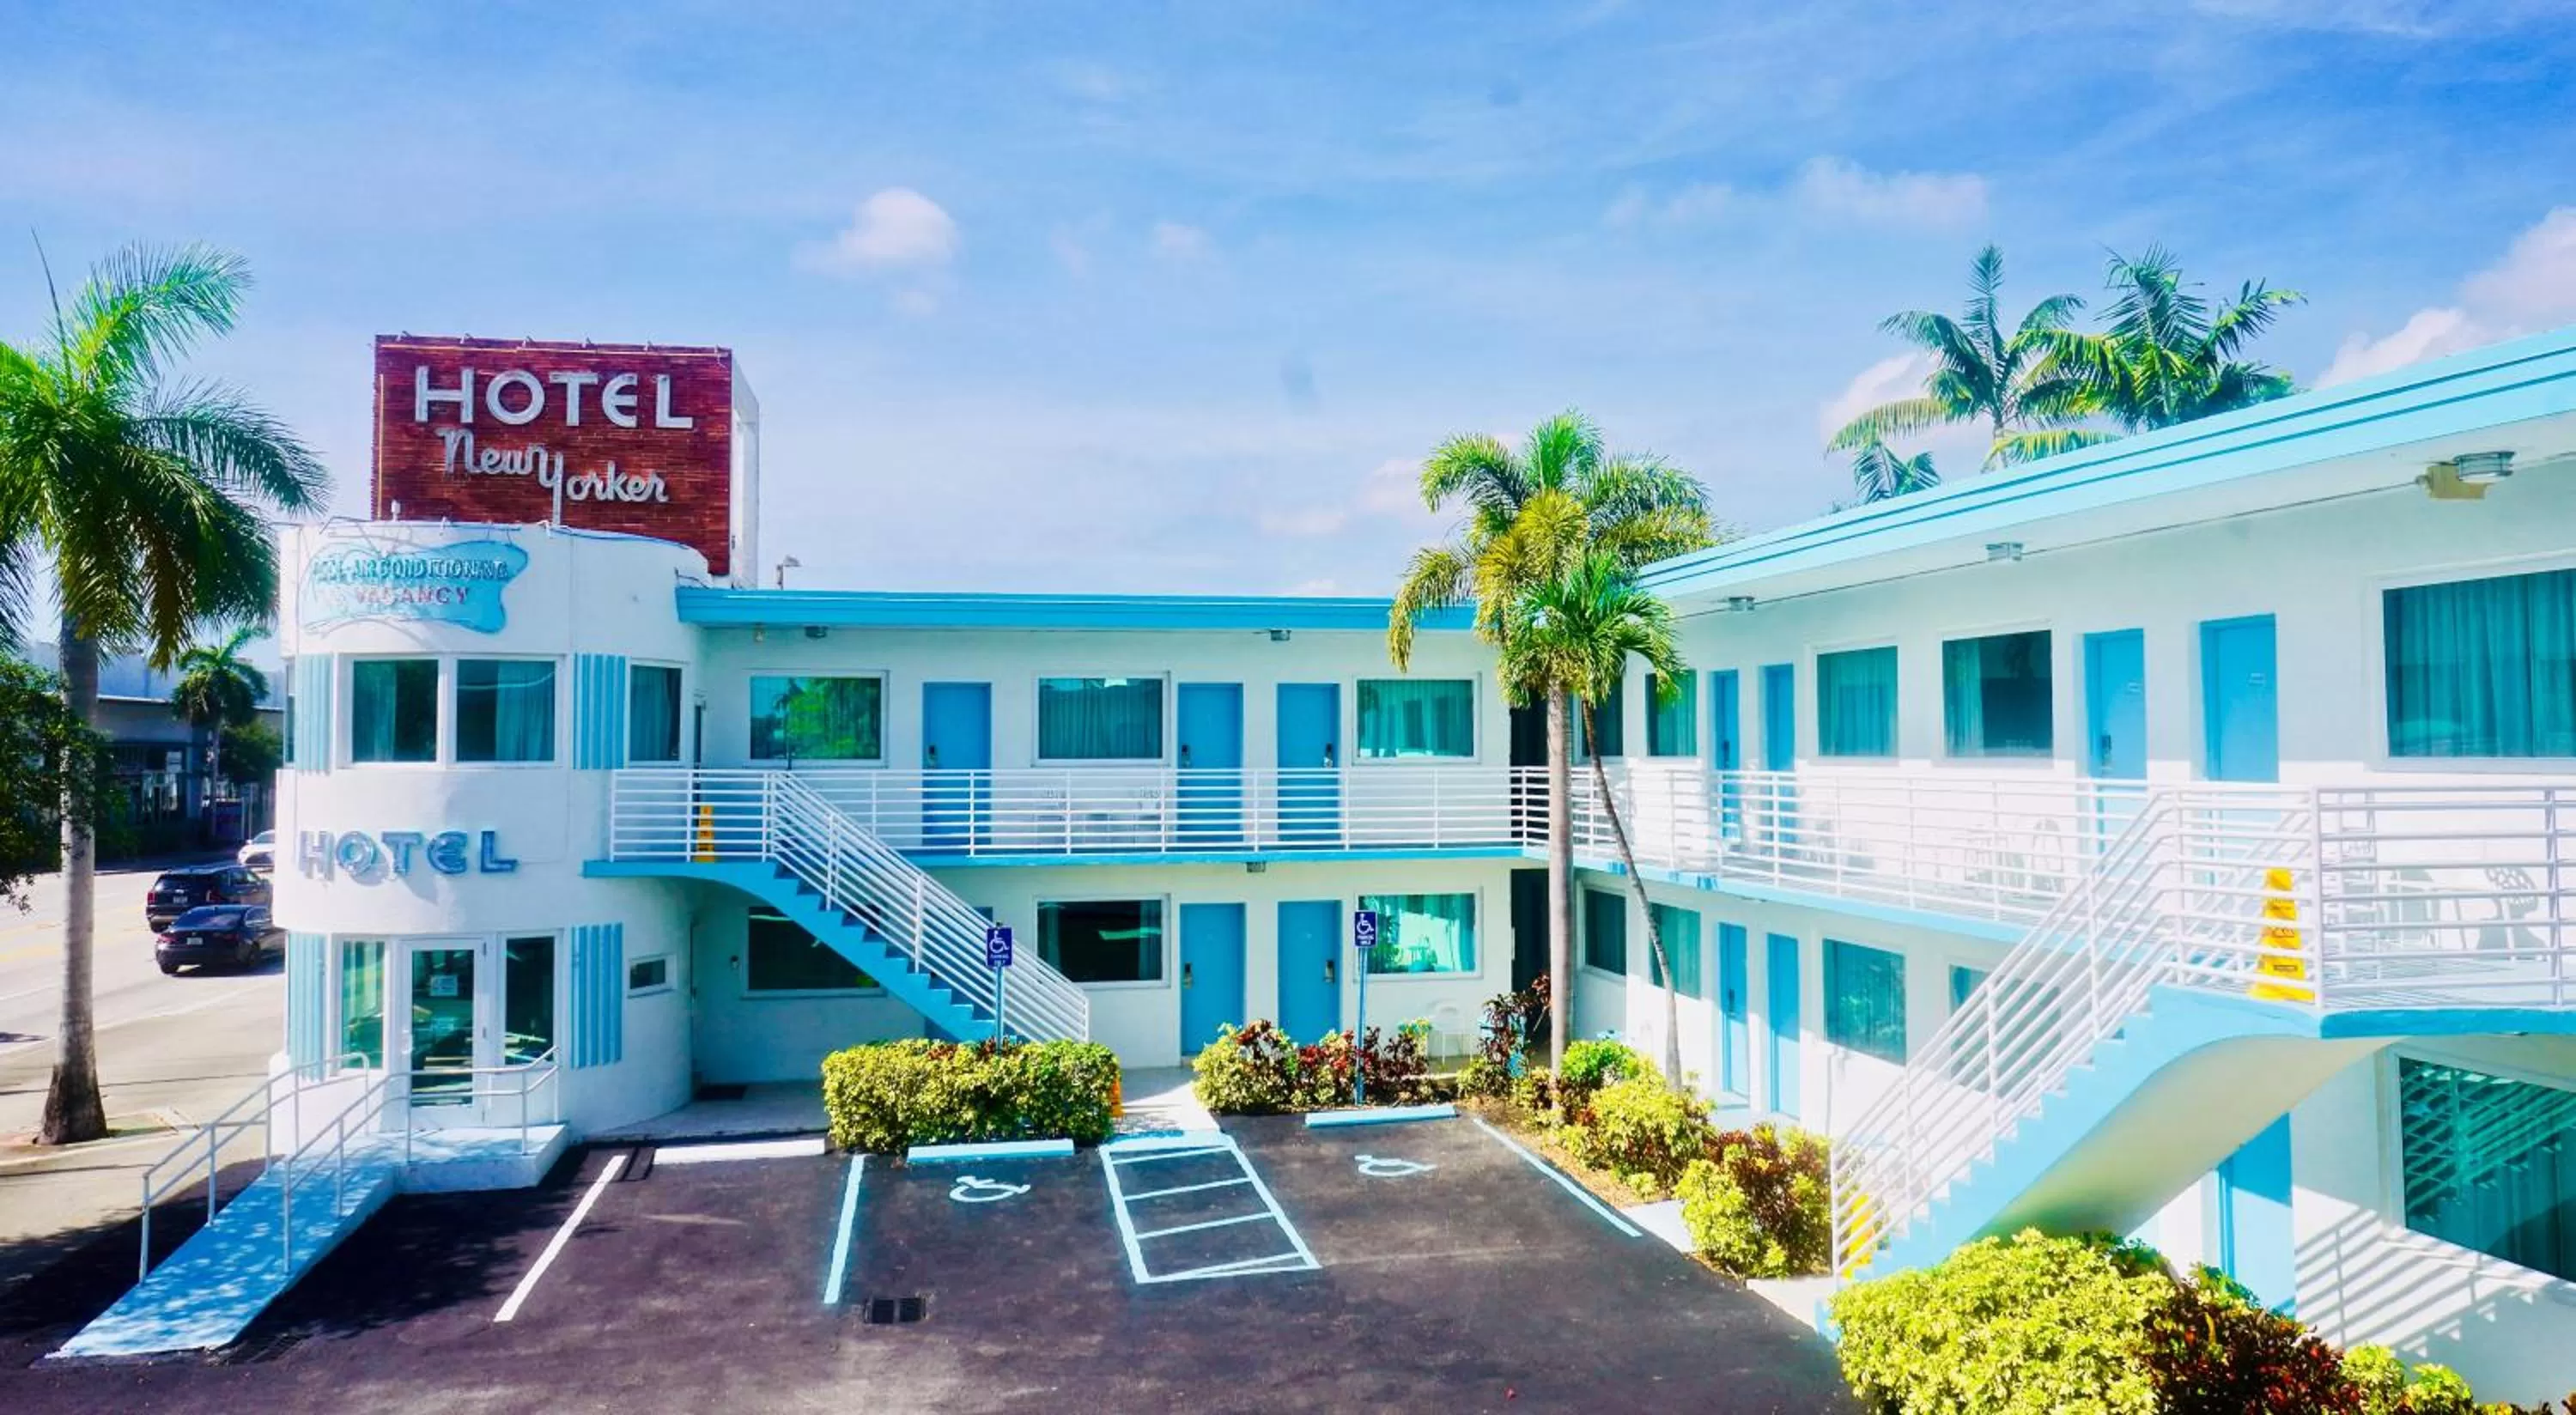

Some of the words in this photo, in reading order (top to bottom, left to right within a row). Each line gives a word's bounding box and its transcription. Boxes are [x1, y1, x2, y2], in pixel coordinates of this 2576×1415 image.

[414, 365, 696, 430] HOTEL
[434, 427, 536, 476] New
[526, 442, 670, 526] Yorker
[355, 584, 471, 606] VACANCY
[298, 829, 518, 877] HOTEL
